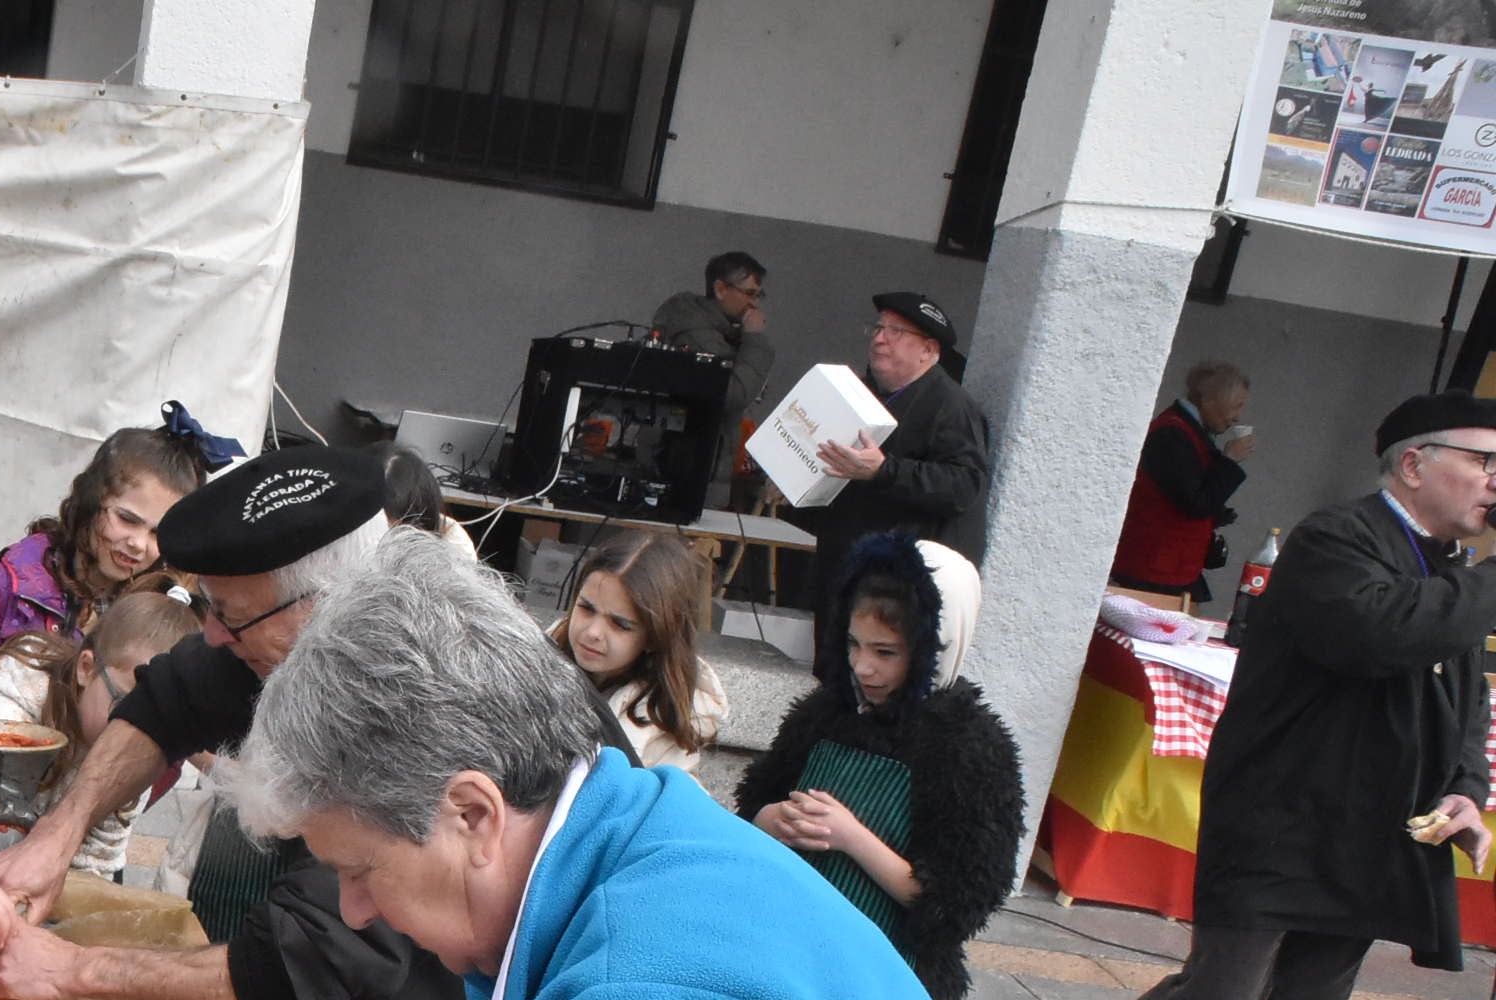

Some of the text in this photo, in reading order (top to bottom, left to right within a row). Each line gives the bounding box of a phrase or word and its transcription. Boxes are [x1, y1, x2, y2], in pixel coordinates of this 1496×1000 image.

[1323, 6, 1368, 20] Nazareno
[774, 416, 819, 474] Traspinedo
[242, 469, 330, 520] MATANZA TIPICA
[248, 480, 336, 523] TRADICIONAL
[256, 479, 315, 506] LEDRADA
